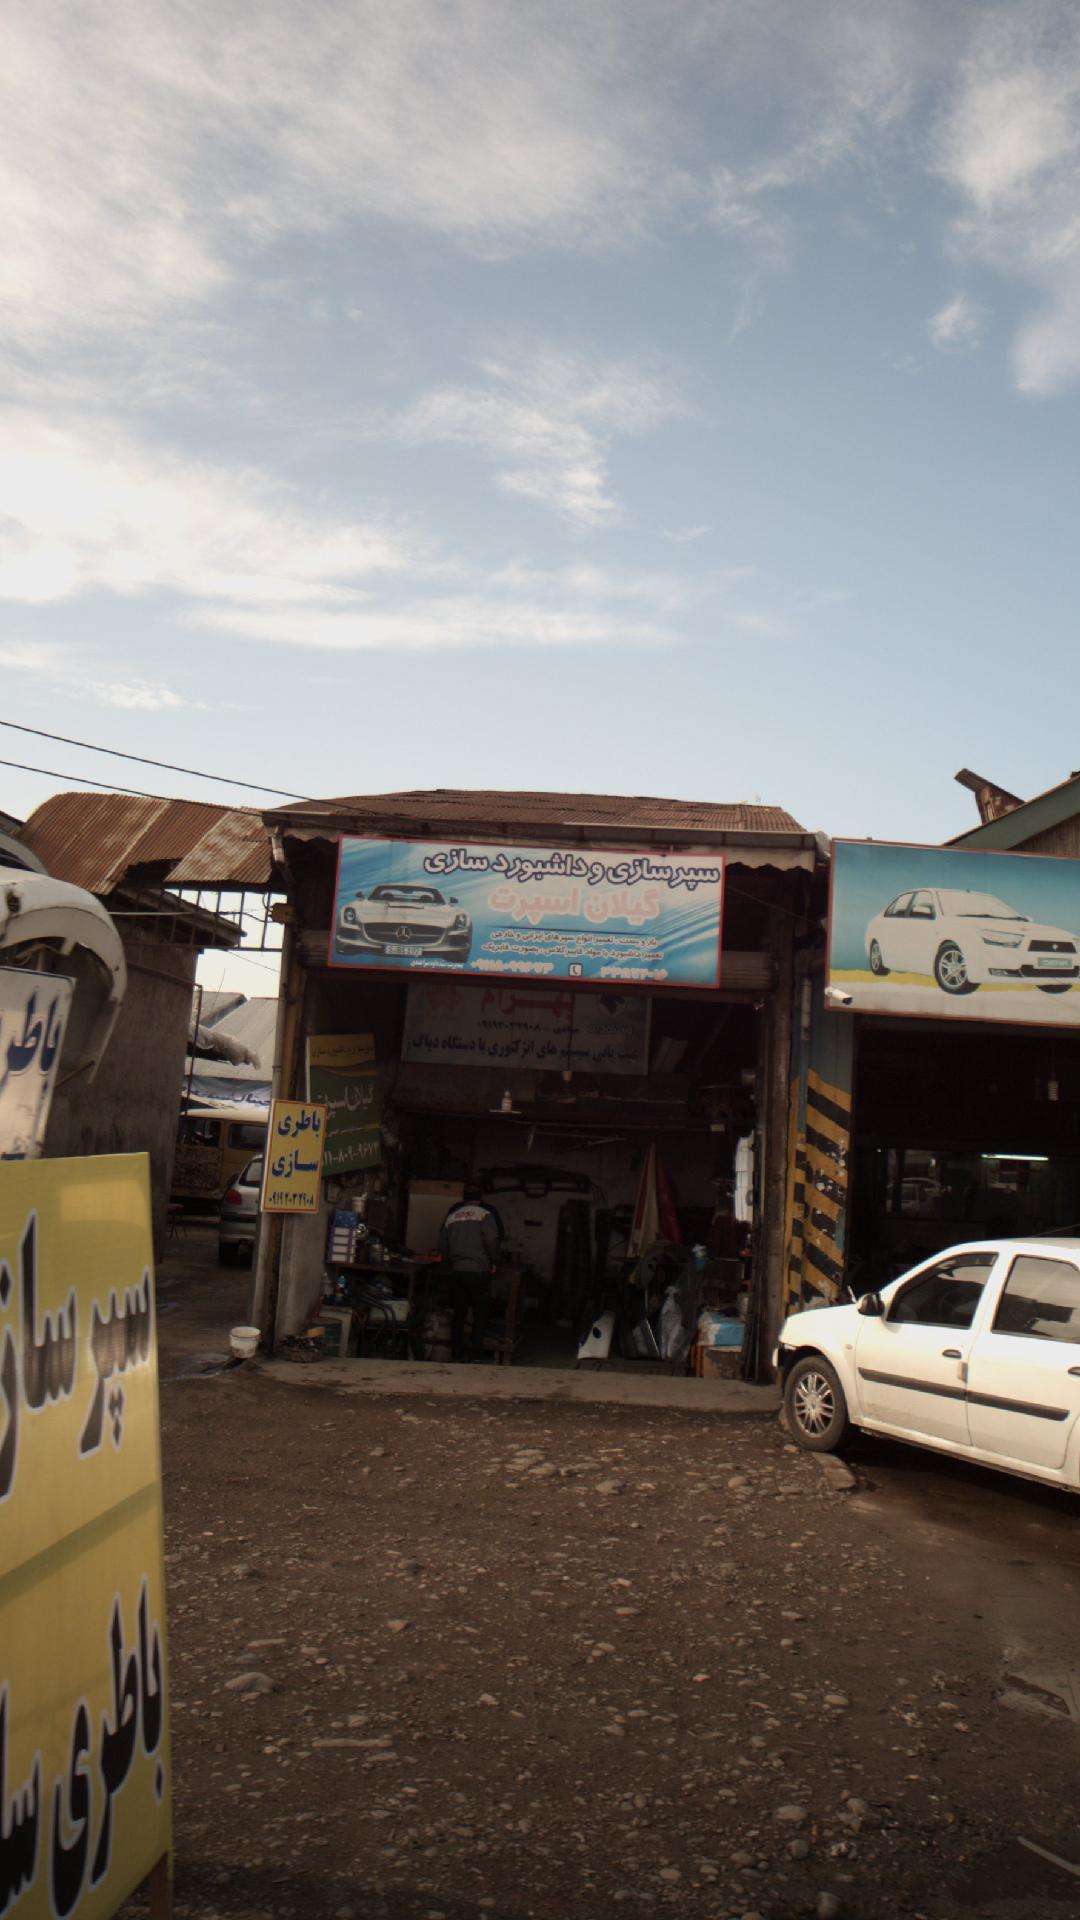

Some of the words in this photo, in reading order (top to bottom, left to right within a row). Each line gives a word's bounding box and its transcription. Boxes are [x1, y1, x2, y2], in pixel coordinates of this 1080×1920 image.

[423, 848, 489, 876] سازی
[607, 858, 670, 886] سازی
[669, 865, 721, 891] سپر
[488, 886, 580, 925] اسپرت
[583, 887, 663, 923] گیلان
[277, 1108, 321, 1138] باطری
[271, 1149, 320, 1178] سازی
[0, 1208, 77, 1501] ساز
[77, 1264, 152, 1460] سپر
[49, 1572, 164, 1920] باطری
